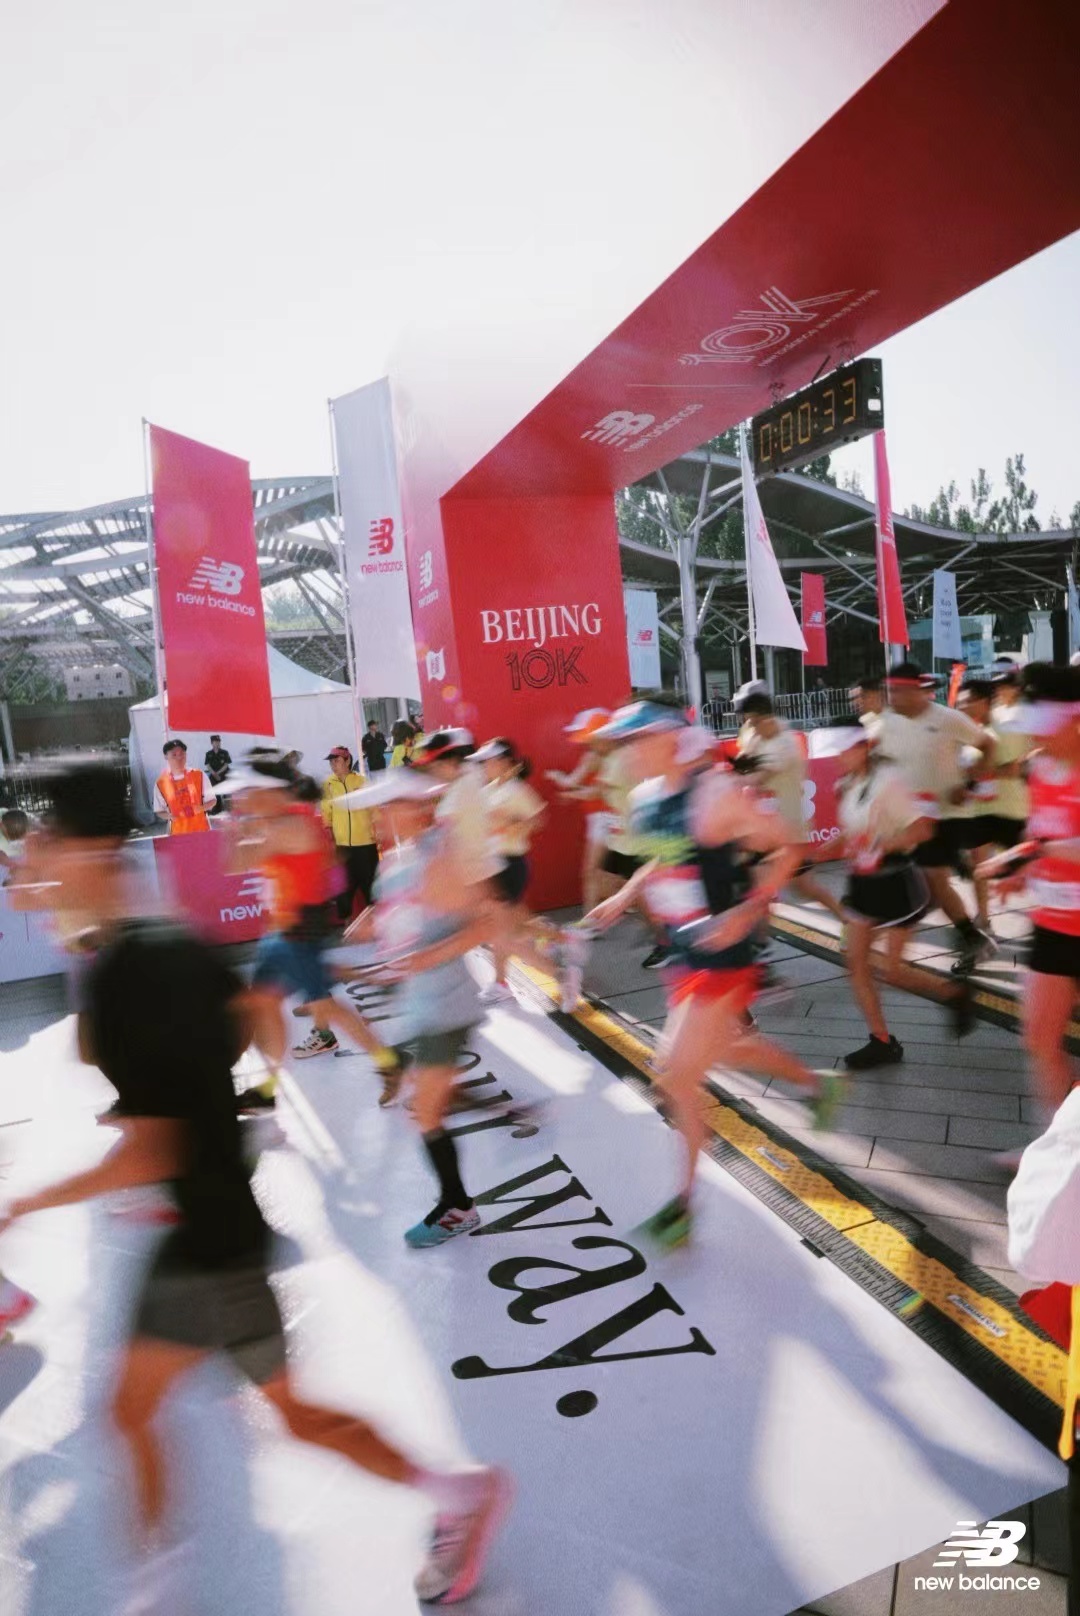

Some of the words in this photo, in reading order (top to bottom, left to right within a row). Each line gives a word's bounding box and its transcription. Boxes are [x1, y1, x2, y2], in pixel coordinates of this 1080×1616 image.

[678, 286, 855, 365] 10K
[760, 376, 856, 462] 0:00:33
[188, 556, 245, 595] NB
[176, 592, 206, 605] new
[207, 594, 256, 617] balance
[480, 603, 602, 648] BEIJING
[504, 646, 589, 691] 10K
[220, 903, 263, 923] new
[451, 1153, 717, 1418] way.
